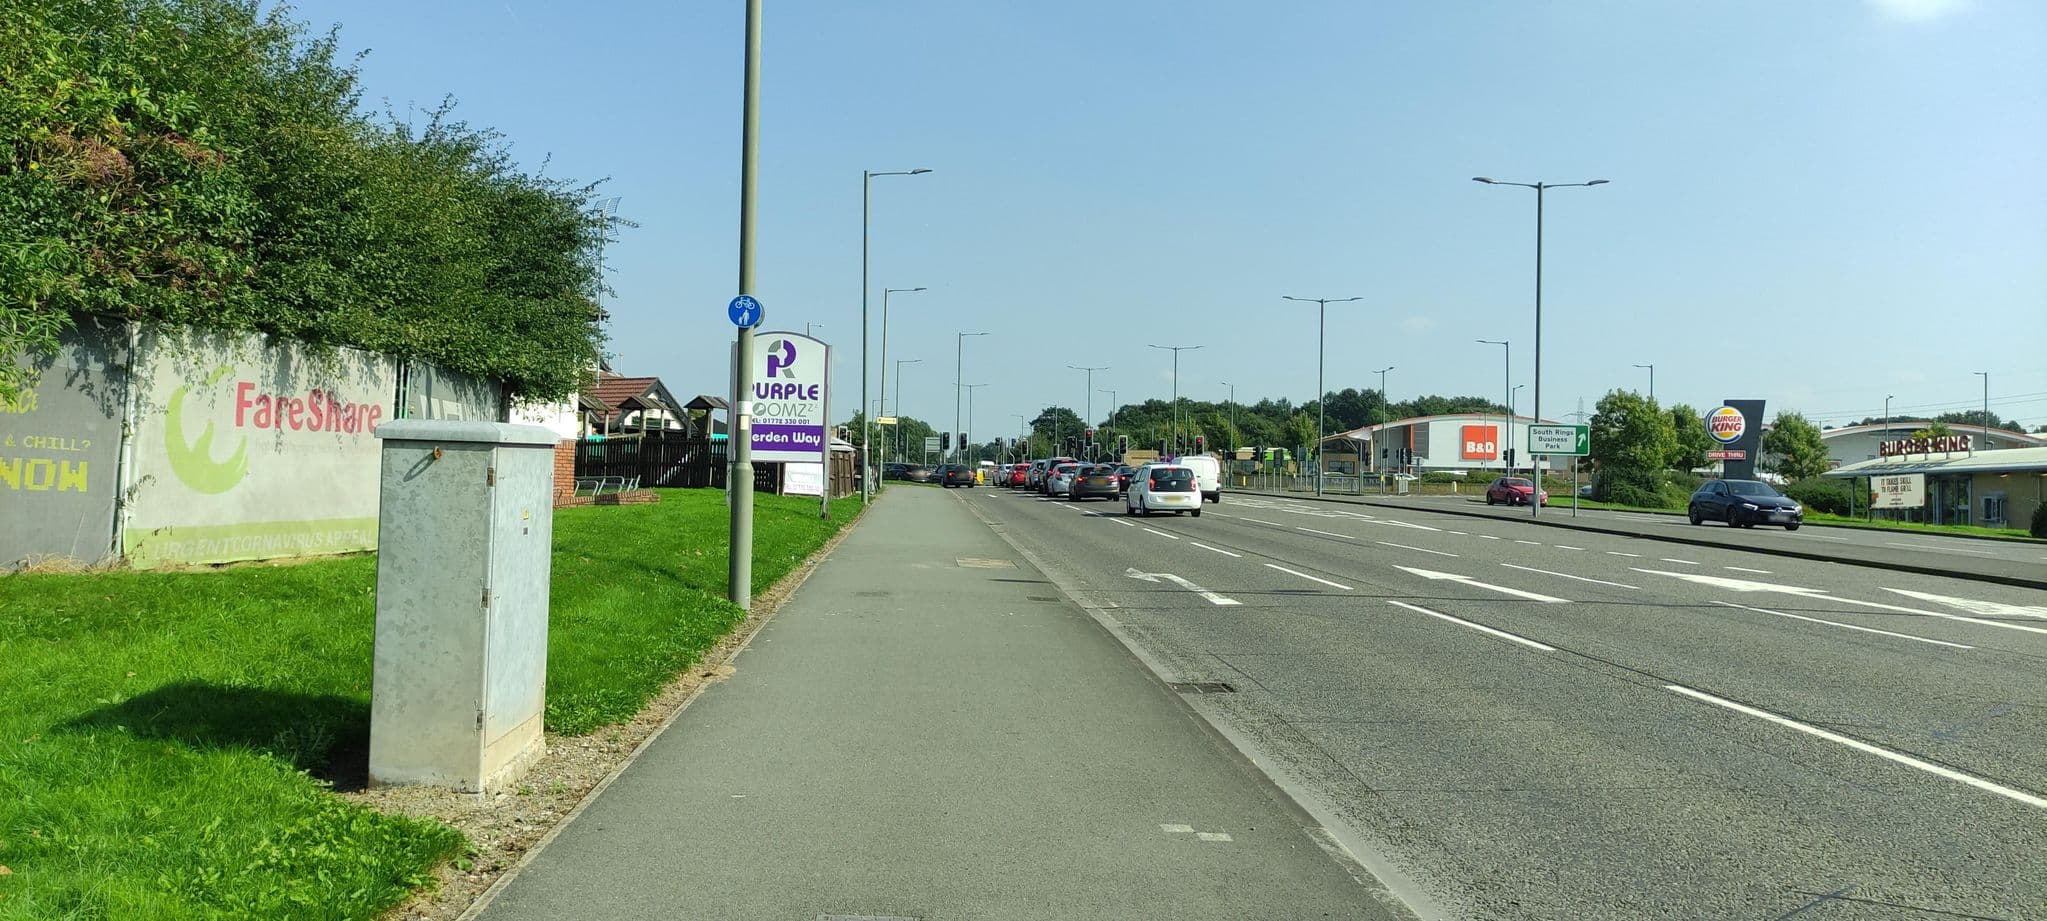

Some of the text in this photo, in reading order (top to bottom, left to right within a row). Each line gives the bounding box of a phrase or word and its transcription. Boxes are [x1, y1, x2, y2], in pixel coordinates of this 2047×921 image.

[753, 382, 819, 400] URPLE
[235, 382, 383, 434] FareShare
[1711, 423, 1742, 432] KING
[1712, 415, 1742, 424] BURGER
[23, 435, 92, 452] CHILL?
[752, 432, 821, 447] erden Way
[1466, 441, 1495, 453] B&Q
[1880, 435, 1969, 457] BURGER KING
[0, 457, 88, 492] NOW
[327, 527, 374, 545] APPEAL
